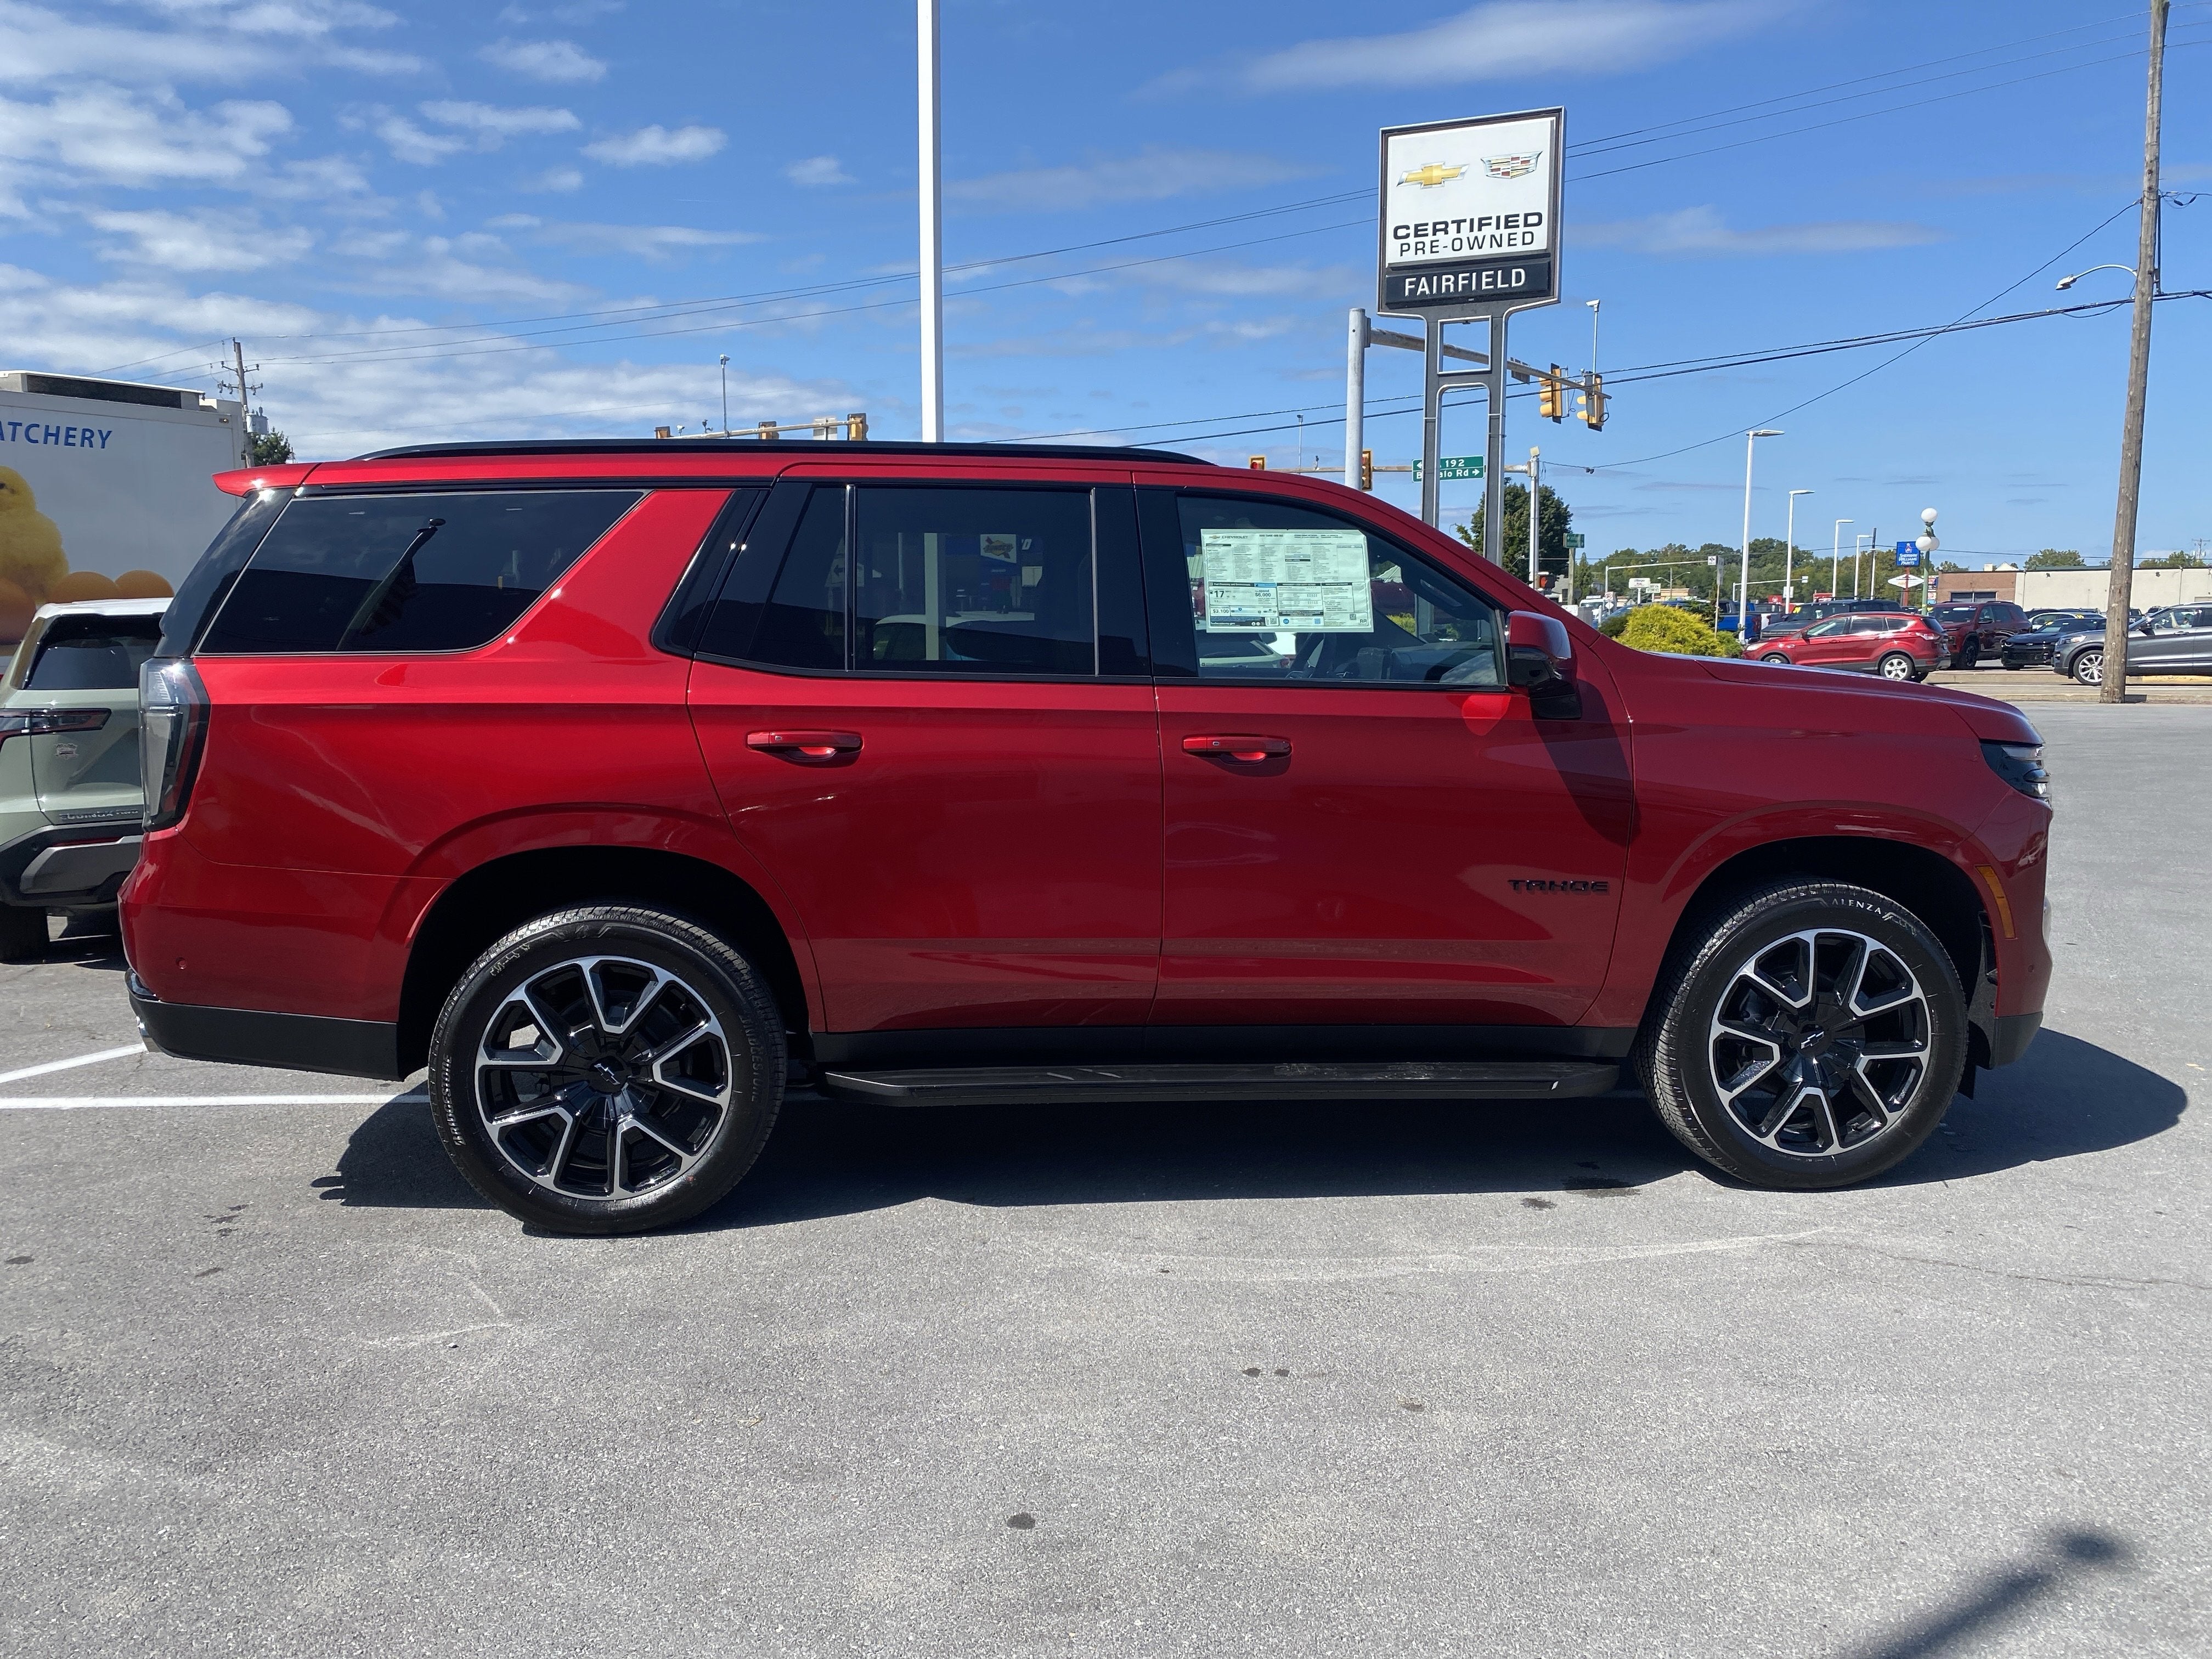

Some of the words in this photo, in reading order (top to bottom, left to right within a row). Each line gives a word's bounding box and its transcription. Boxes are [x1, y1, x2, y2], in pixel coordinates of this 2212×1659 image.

[1393, 212, 1543, 240] CERTIFIED
[1400, 231, 1534, 257] PRE-OWNED
[1404, 268, 1526, 297] FAIRFIELD
[1445, 459, 1465, 467] 192
[1417, 471, 1453, 479] Balo
[1507, 879, 1609, 893] TAHOE
[1832, 898, 1882, 915] ALENZA
